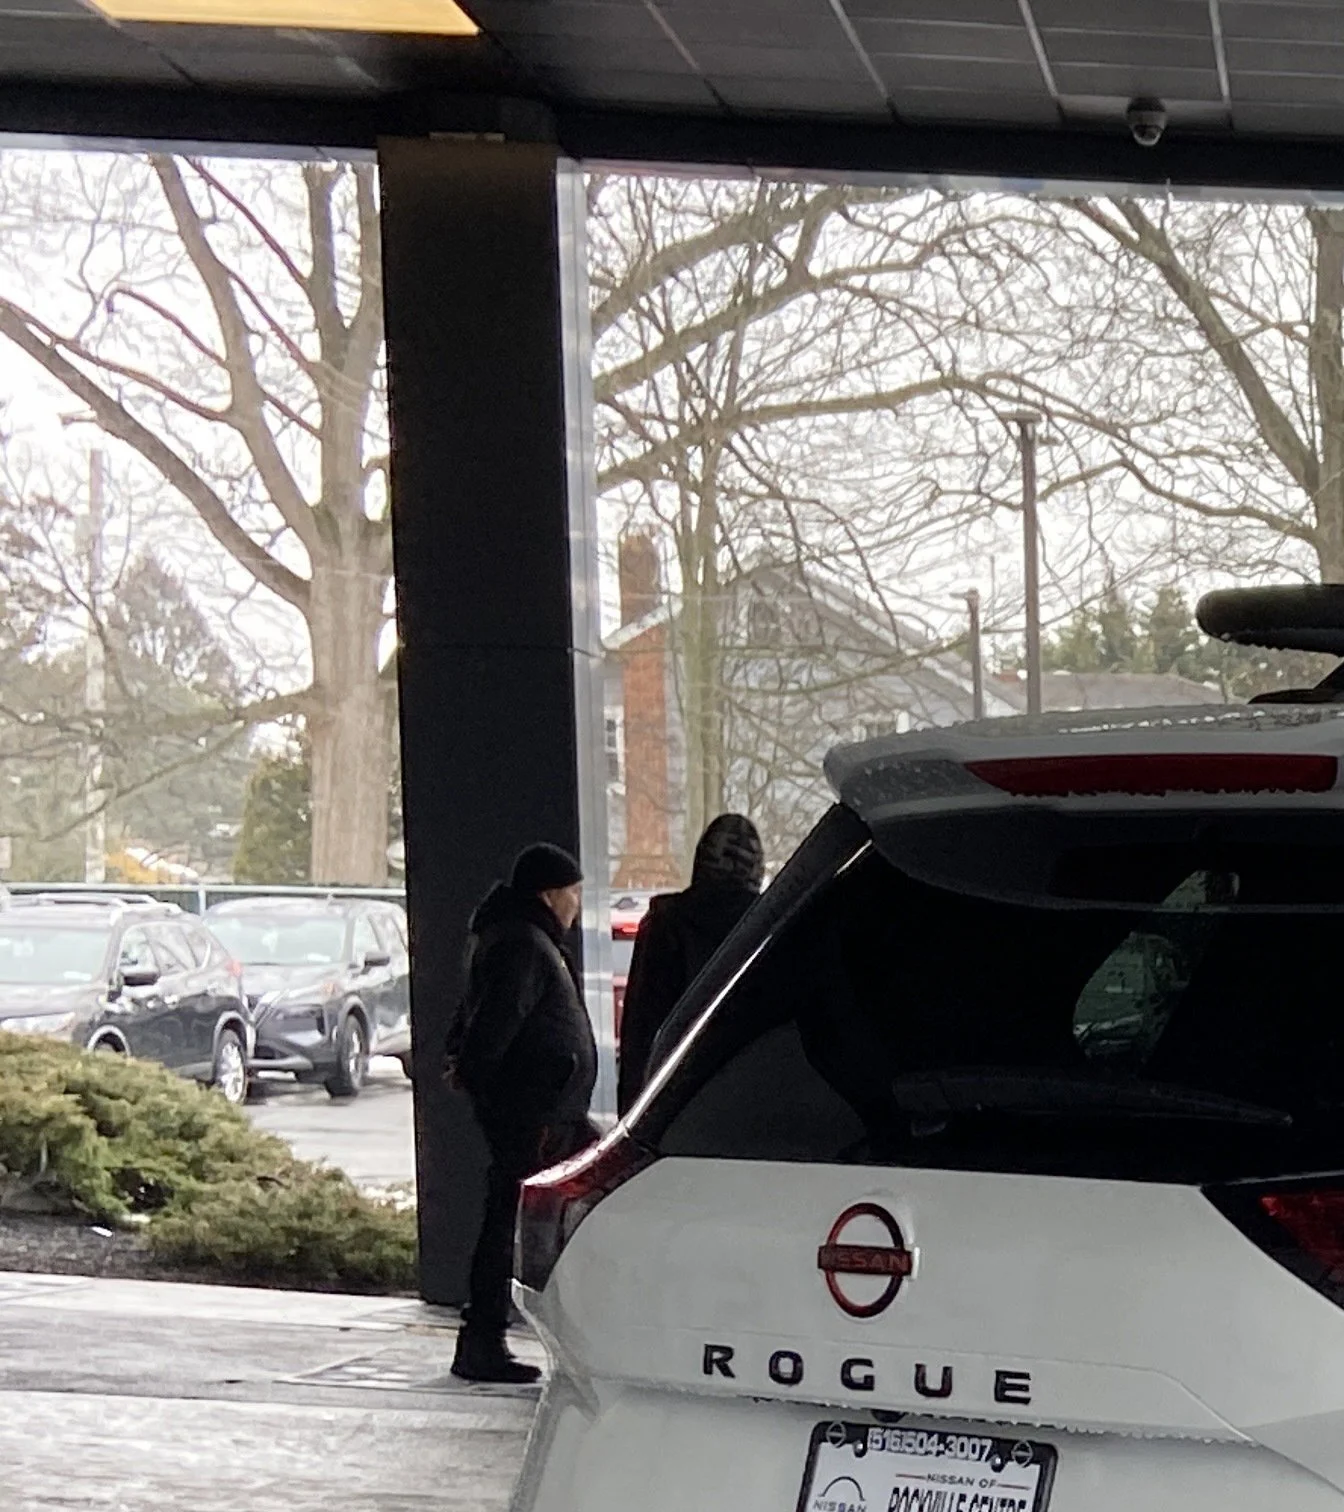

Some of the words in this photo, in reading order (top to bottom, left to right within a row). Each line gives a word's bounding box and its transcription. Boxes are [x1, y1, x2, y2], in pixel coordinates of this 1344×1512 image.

[703, 1344, 1032, 1405] ROGUE
[926, 1473, 975, 1487] NISSAN
[979, 1478, 998, 1489] OF
